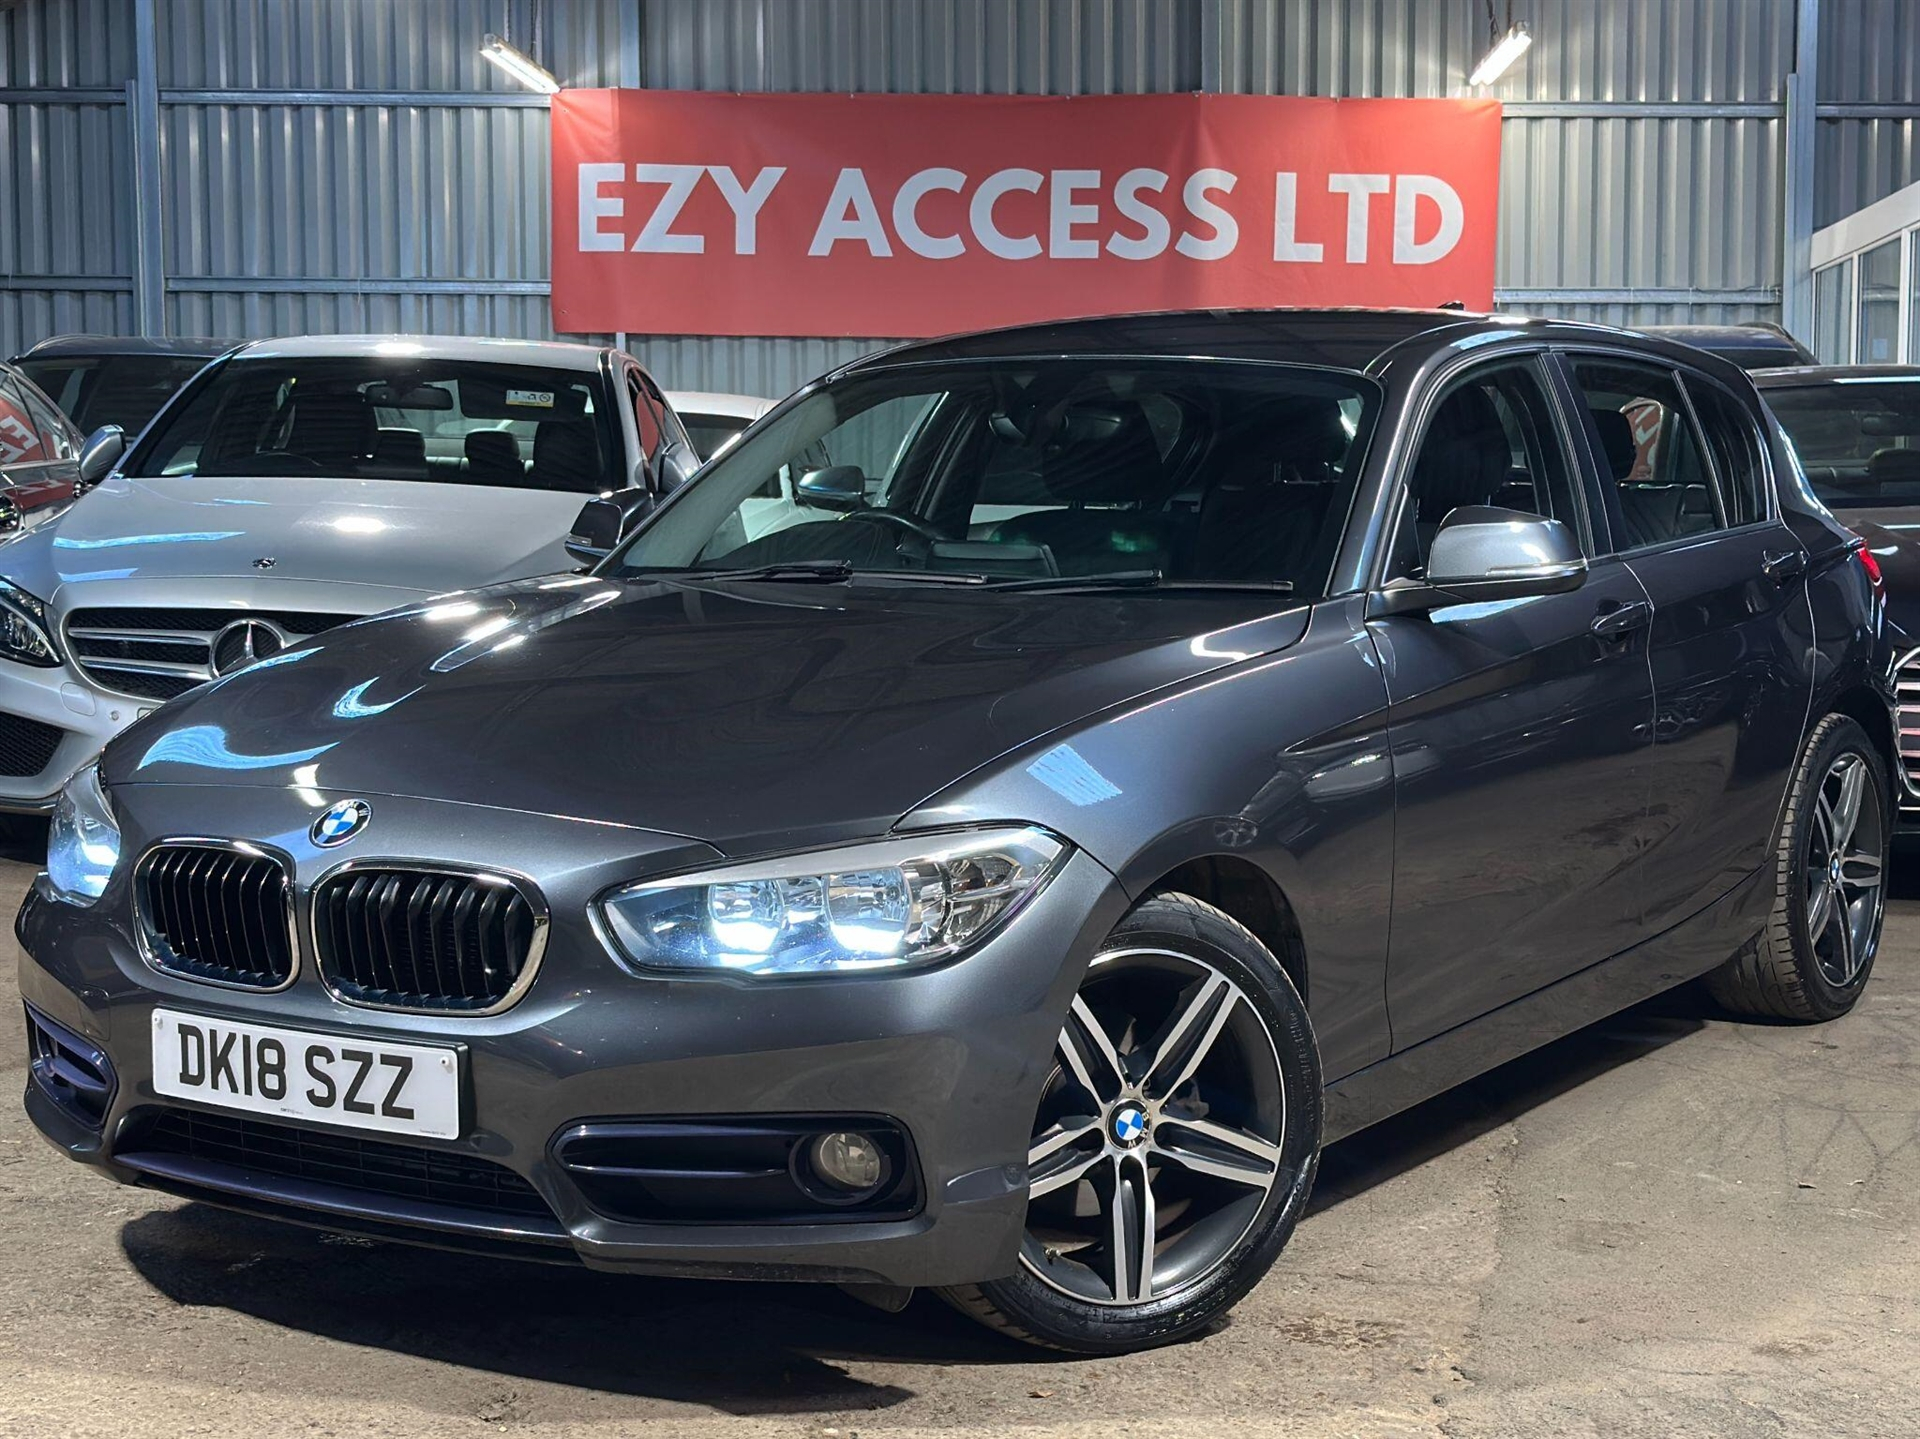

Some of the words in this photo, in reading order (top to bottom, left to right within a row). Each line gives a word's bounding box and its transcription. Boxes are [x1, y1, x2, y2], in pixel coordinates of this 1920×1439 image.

[578, 163, 787, 255] EZY
[808, 167, 1239, 261] ACCESS
[1273, 172, 1465, 265] LTD
[178, 1023, 286, 1100] DK18
[305, 1044, 415, 1120] SZZ
